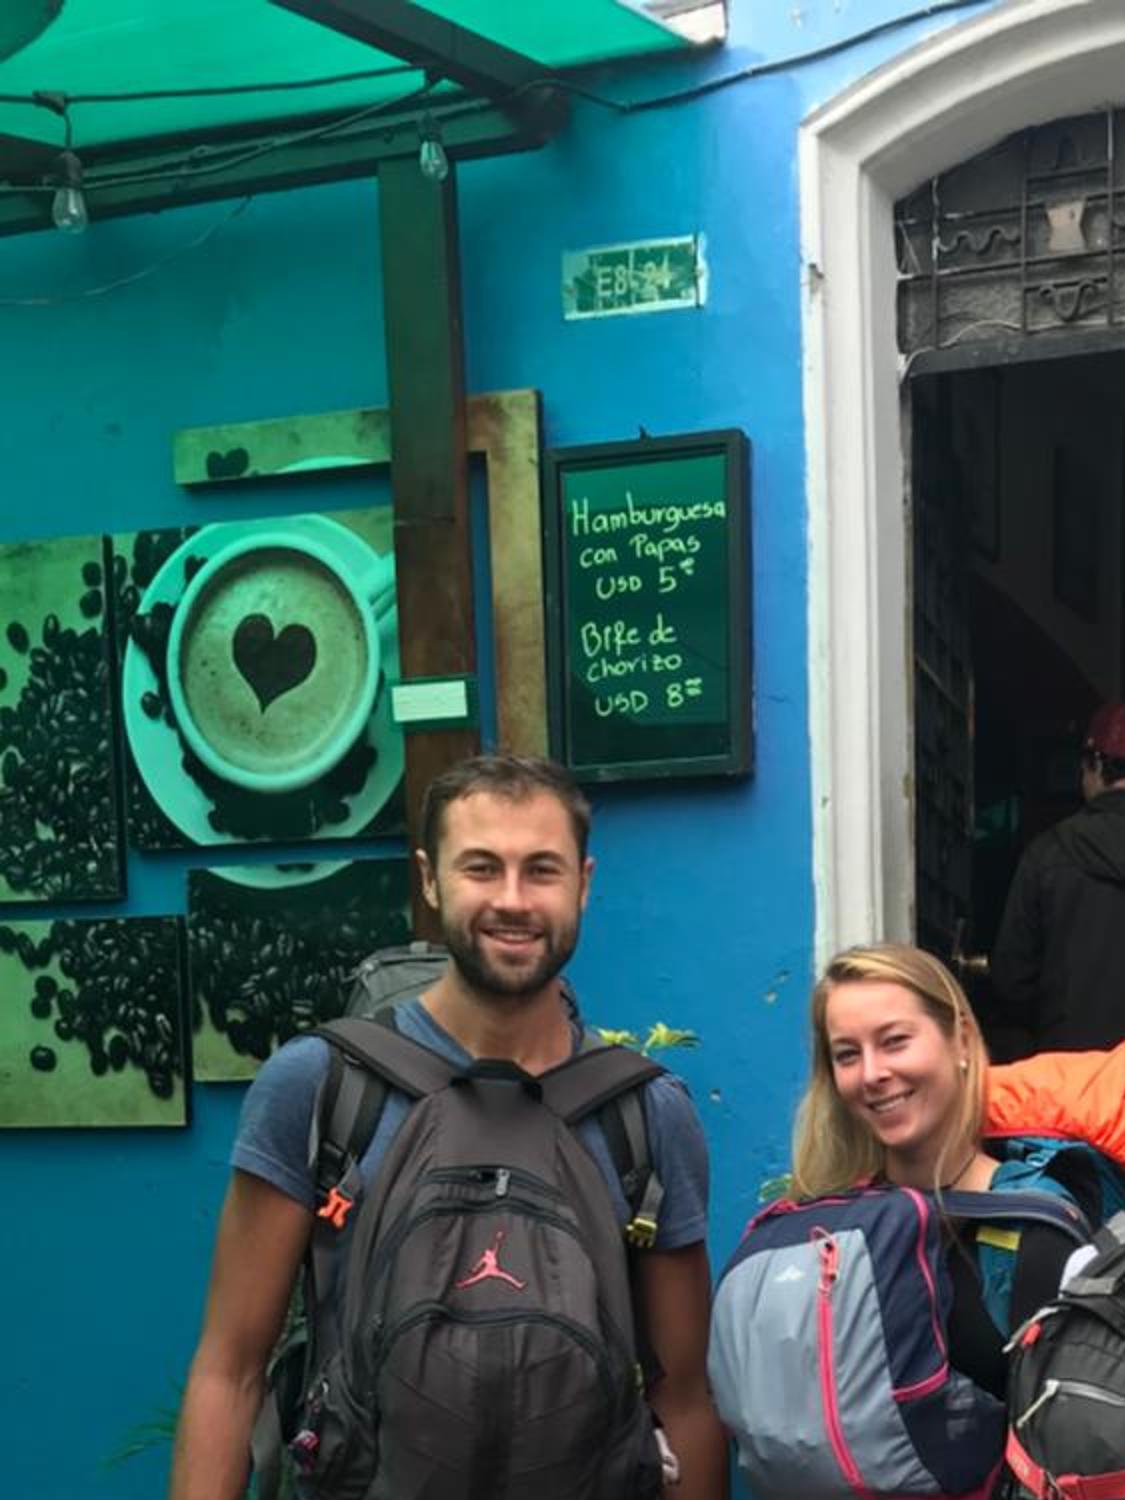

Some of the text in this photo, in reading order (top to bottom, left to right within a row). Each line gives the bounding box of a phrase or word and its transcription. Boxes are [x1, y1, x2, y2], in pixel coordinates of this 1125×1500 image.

[572, 491, 726, 536] Hamburguesa
[580, 533, 701, 568] con Papas
[595, 575, 642, 600] USD
[648, 613, 677, 645] de
[595, 690, 648, 717] USD
